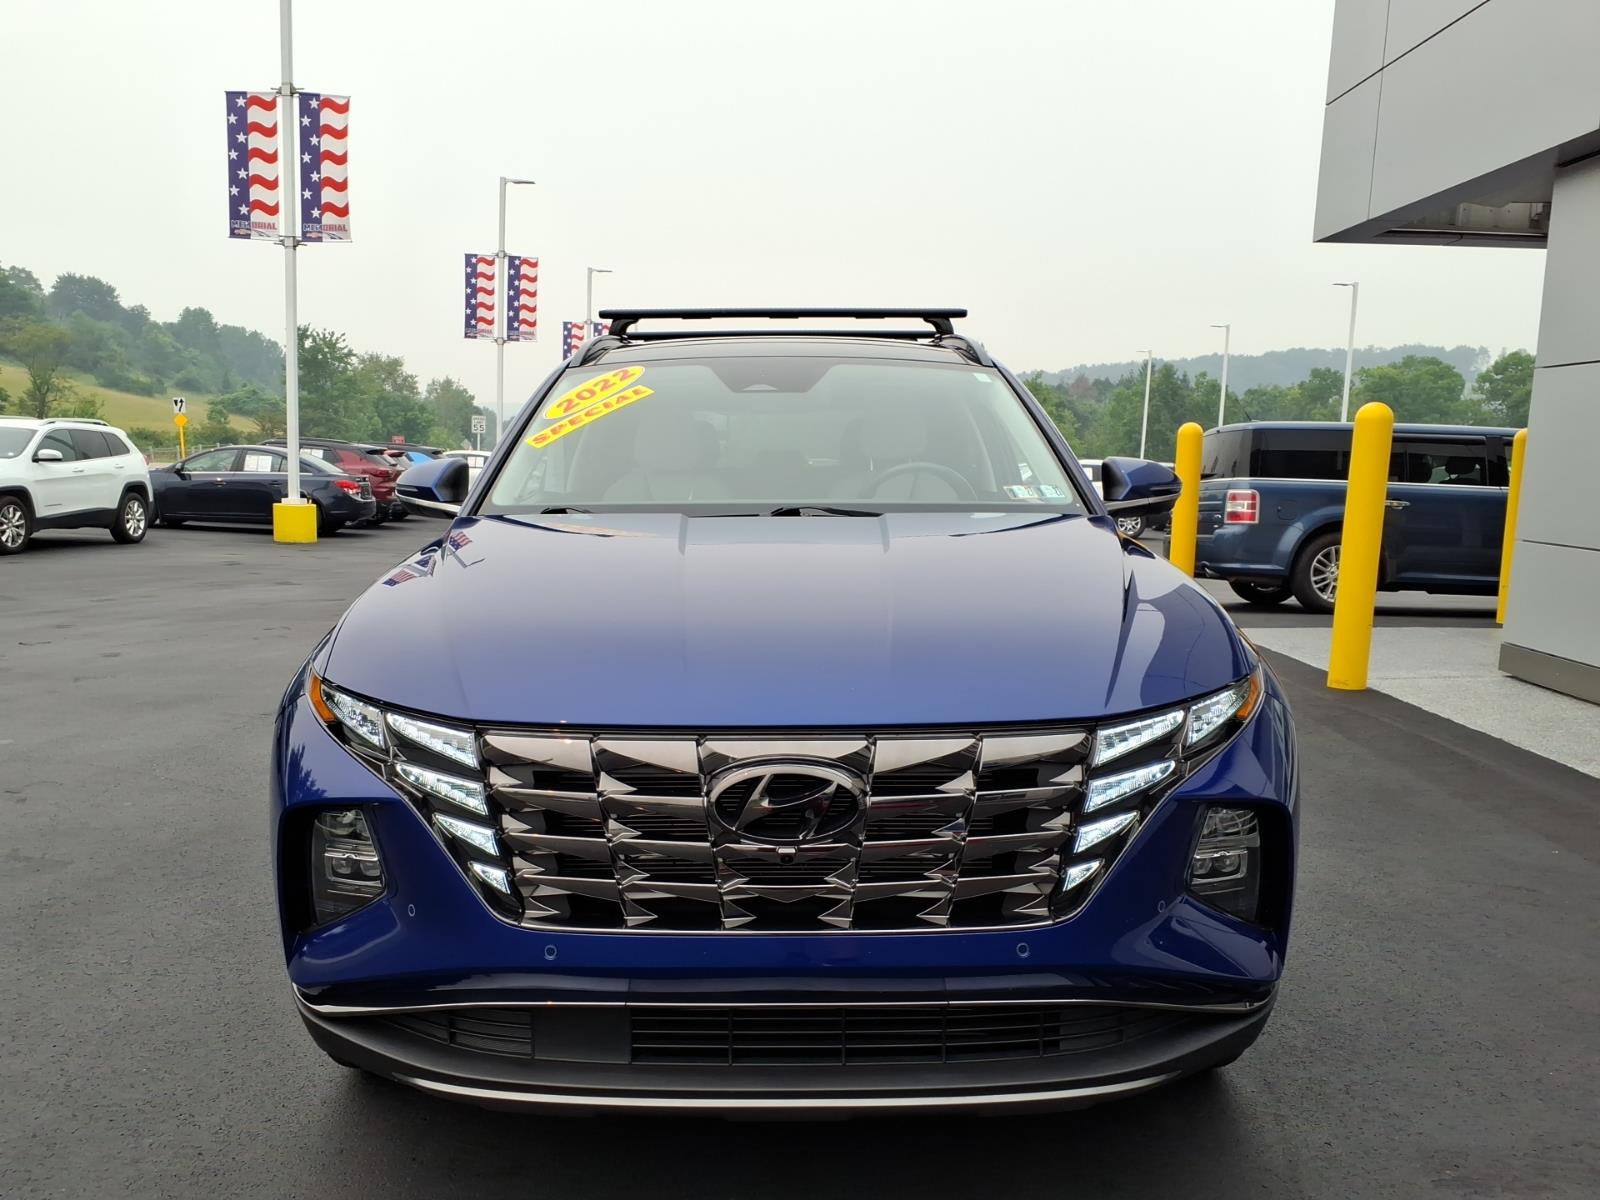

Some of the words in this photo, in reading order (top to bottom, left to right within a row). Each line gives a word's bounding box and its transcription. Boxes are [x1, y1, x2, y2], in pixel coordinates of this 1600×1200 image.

[556, 368, 637, 414] 2022
[473, 424, 485, 432] 55
[532, 387, 649, 445] SPECIAL
